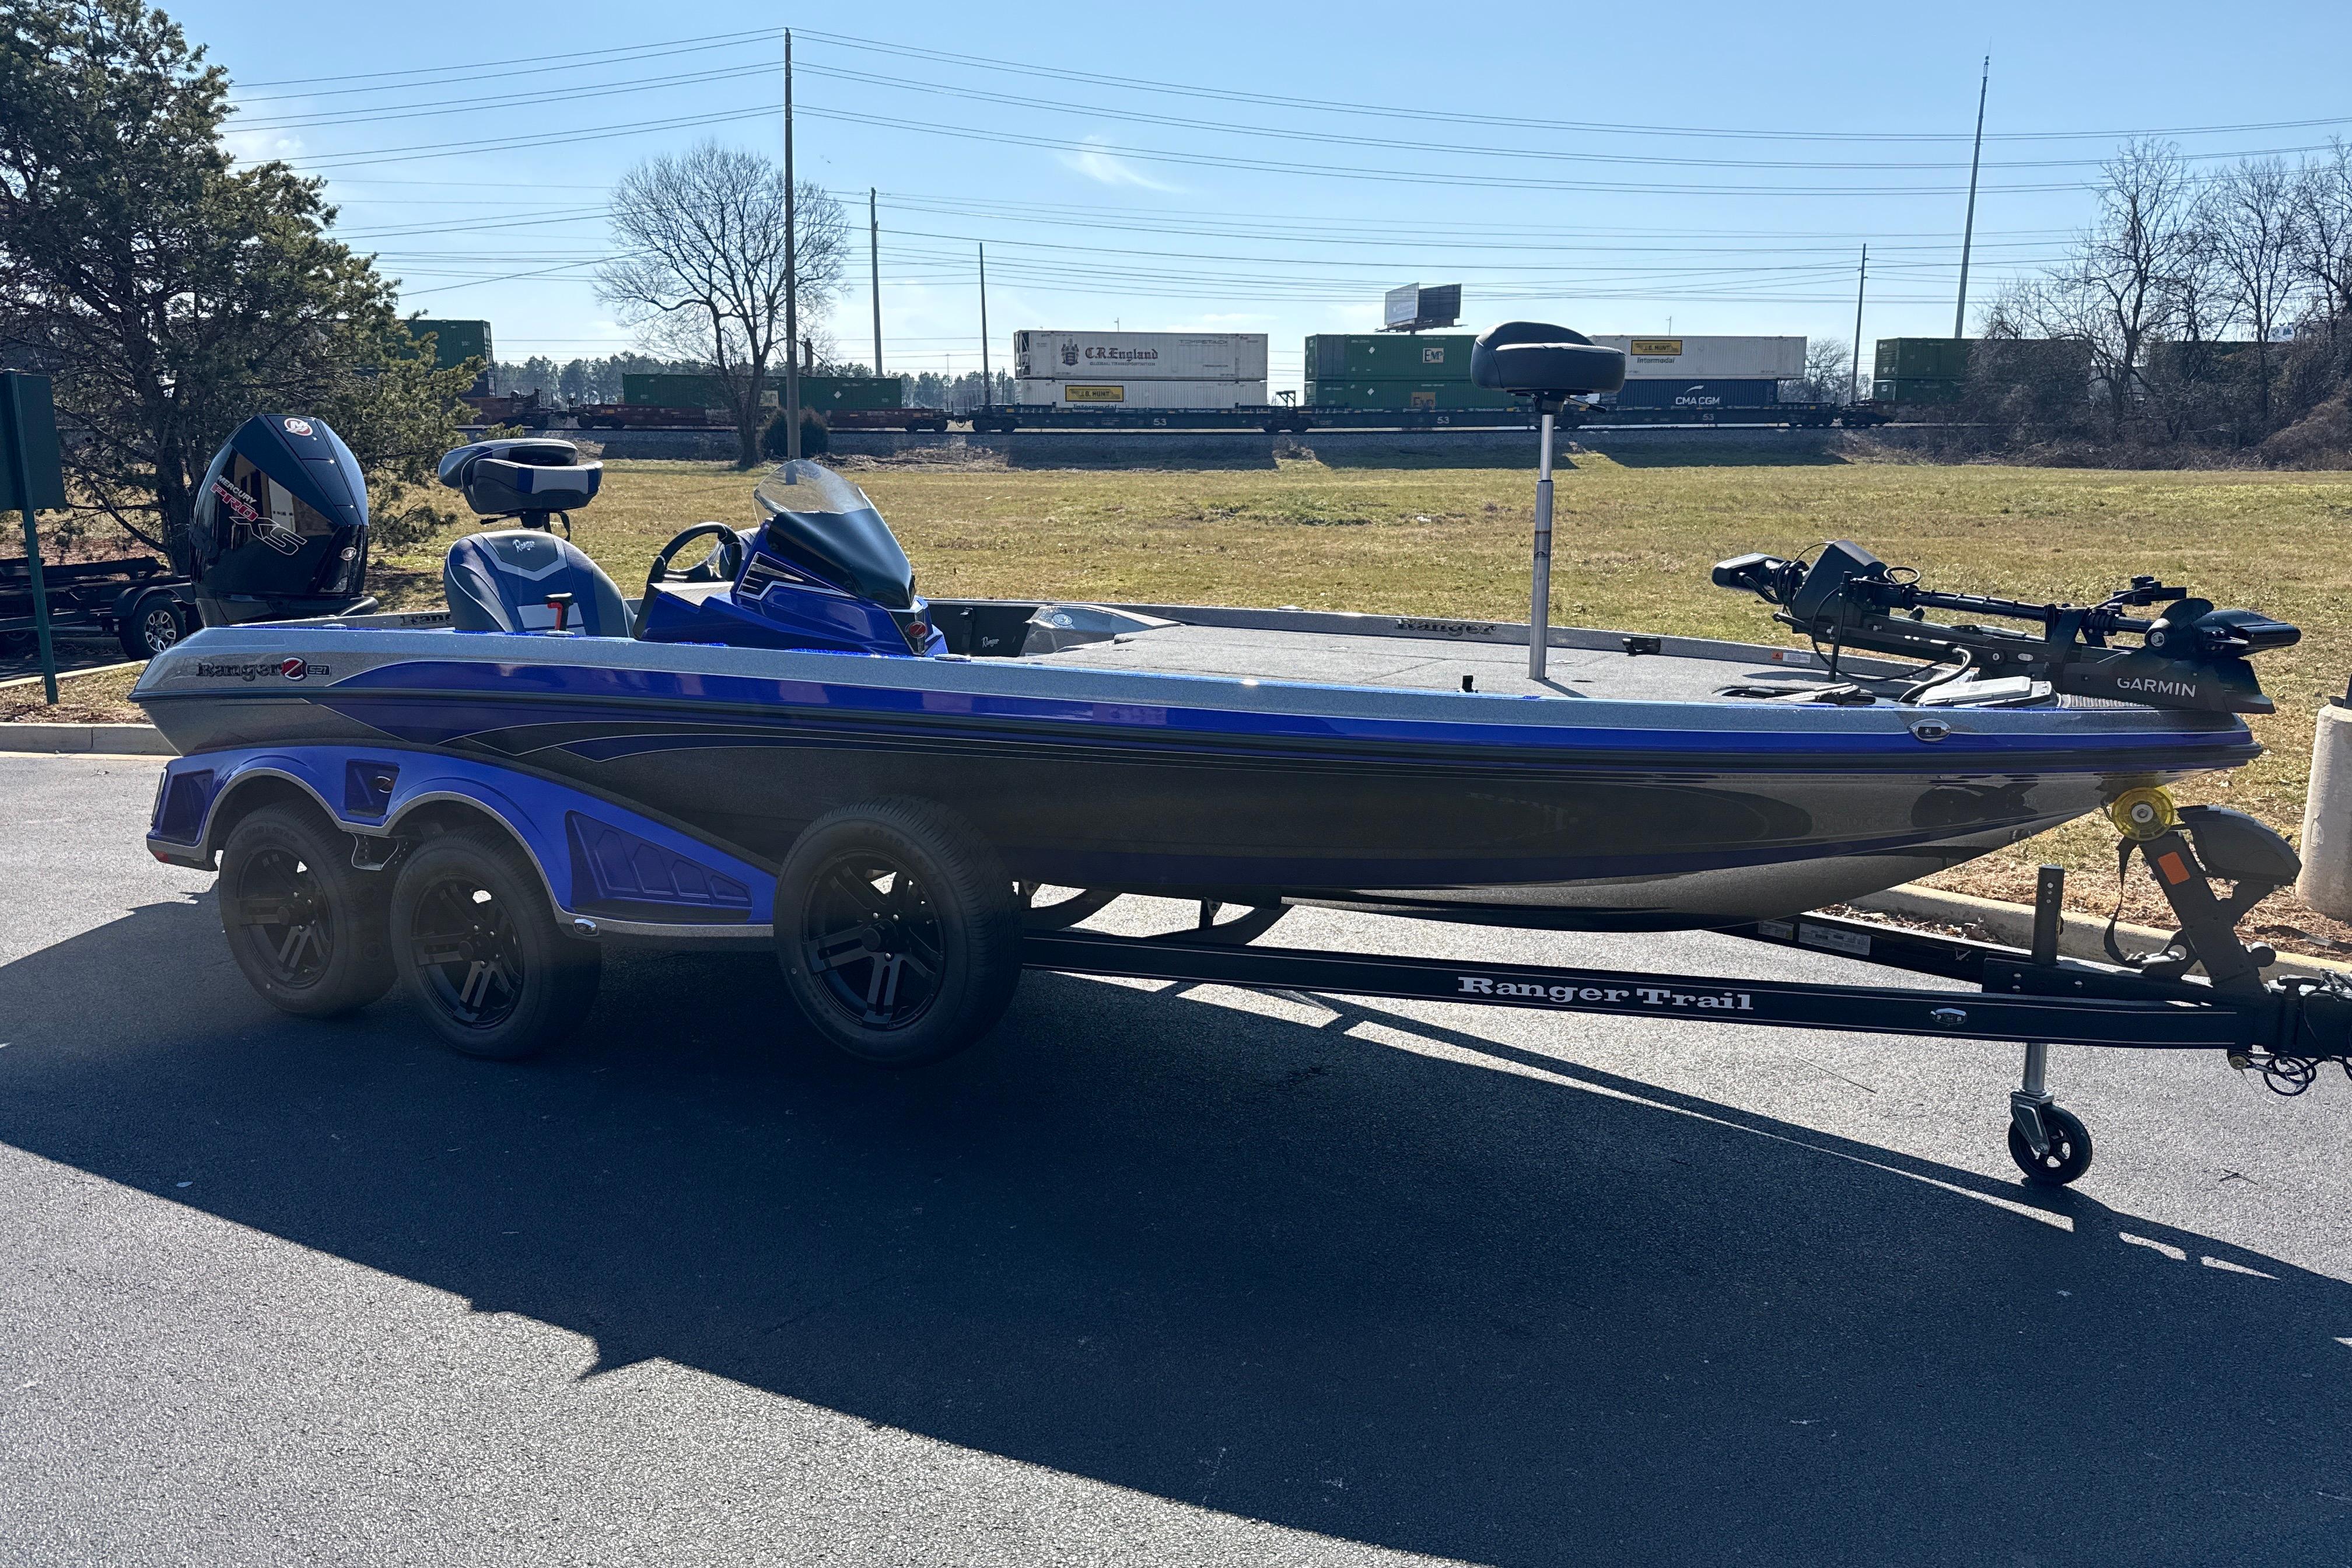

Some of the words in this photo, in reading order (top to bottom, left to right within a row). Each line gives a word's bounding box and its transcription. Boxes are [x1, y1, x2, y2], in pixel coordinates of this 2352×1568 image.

[1675, 397, 1697, 405] CMA
[1699, 397, 1720, 405] CGM
[1153, 418, 1167, 426] 53
[1437, 416, 1450, 424] 53
[216, 474, 257, 505] MERCURY
[210, 482, 259, 522] PRO
[229, 517, 308, 555] XS
[1395, 618, 1497, 637] Ranger
[195, 662, 282, 682] Ranger
[2116, 677, 2196, 697] GARMIN
[1458, 977, 1630, 1003] Ranger
[1636, 988, 1754, 1010] Trail
